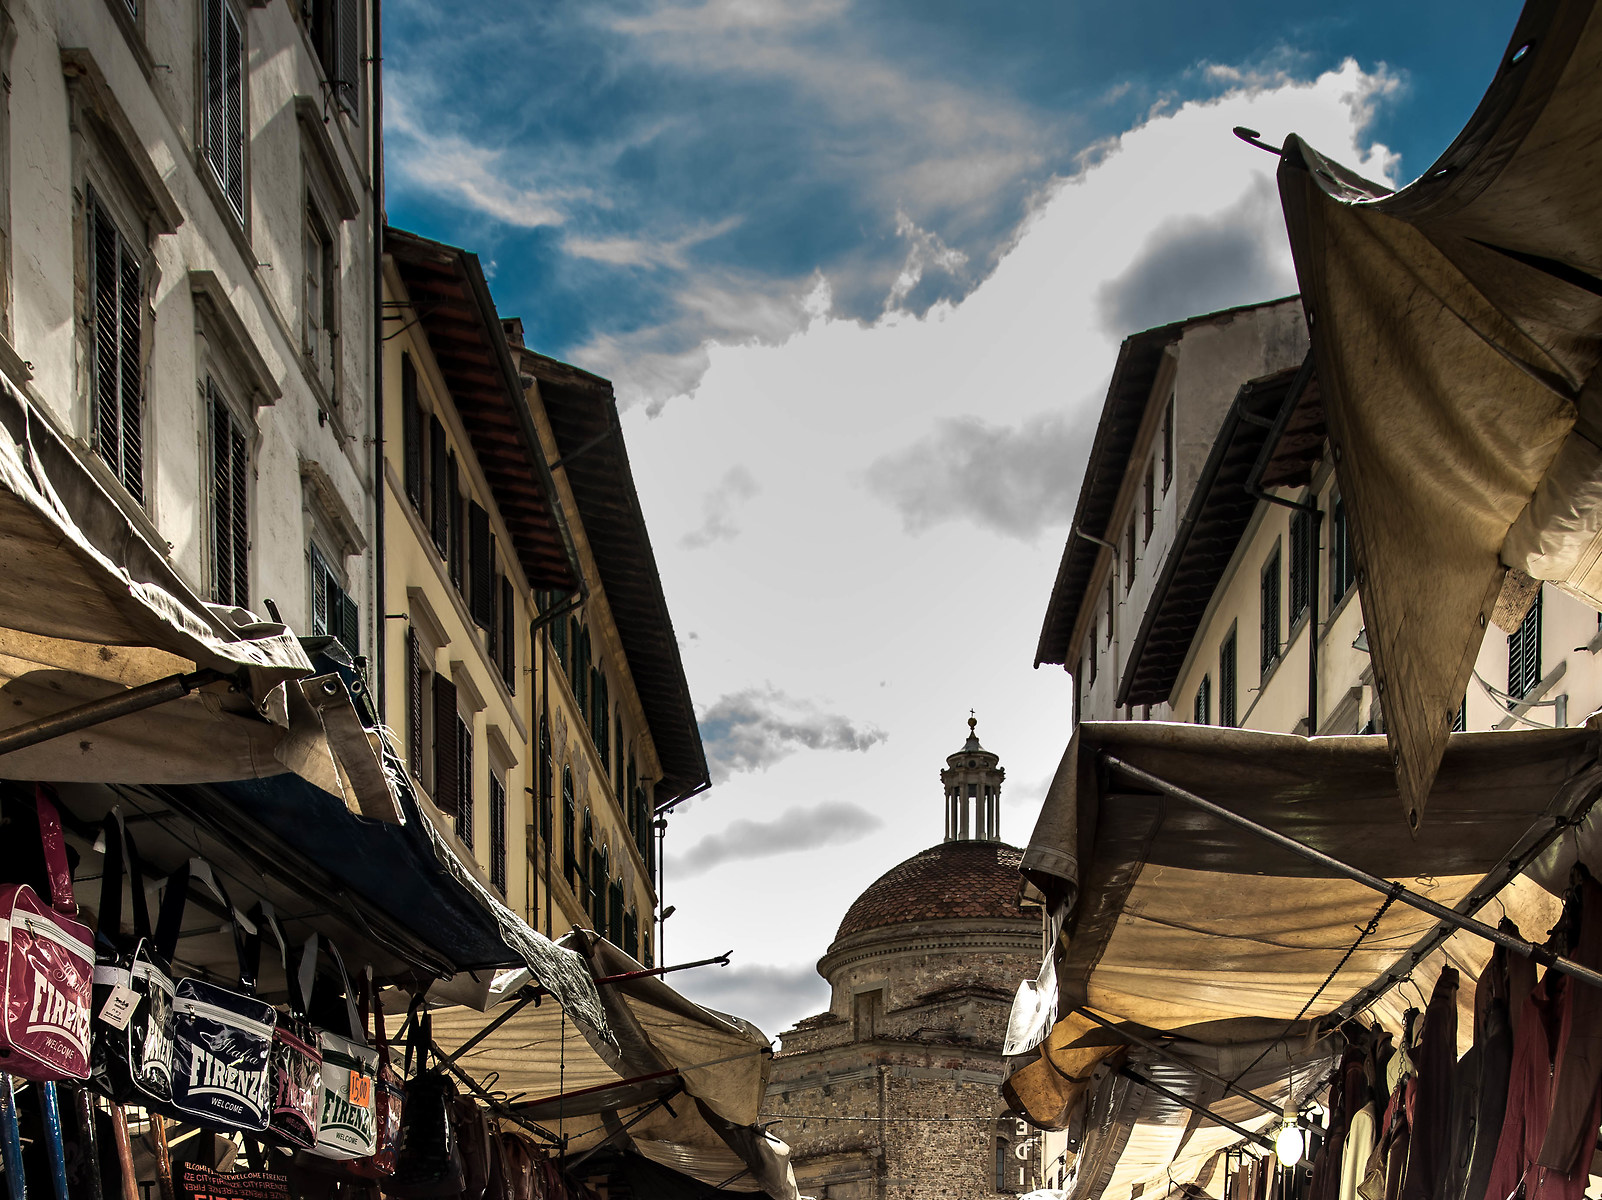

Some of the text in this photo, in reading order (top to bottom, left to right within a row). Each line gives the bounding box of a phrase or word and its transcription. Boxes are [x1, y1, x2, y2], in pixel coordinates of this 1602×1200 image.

[45, 1037, 75, 1059] WELCOME
[210, 1096, 244, 1114] WELCOME
[335, 1131, 359, 1146] WELCOME
